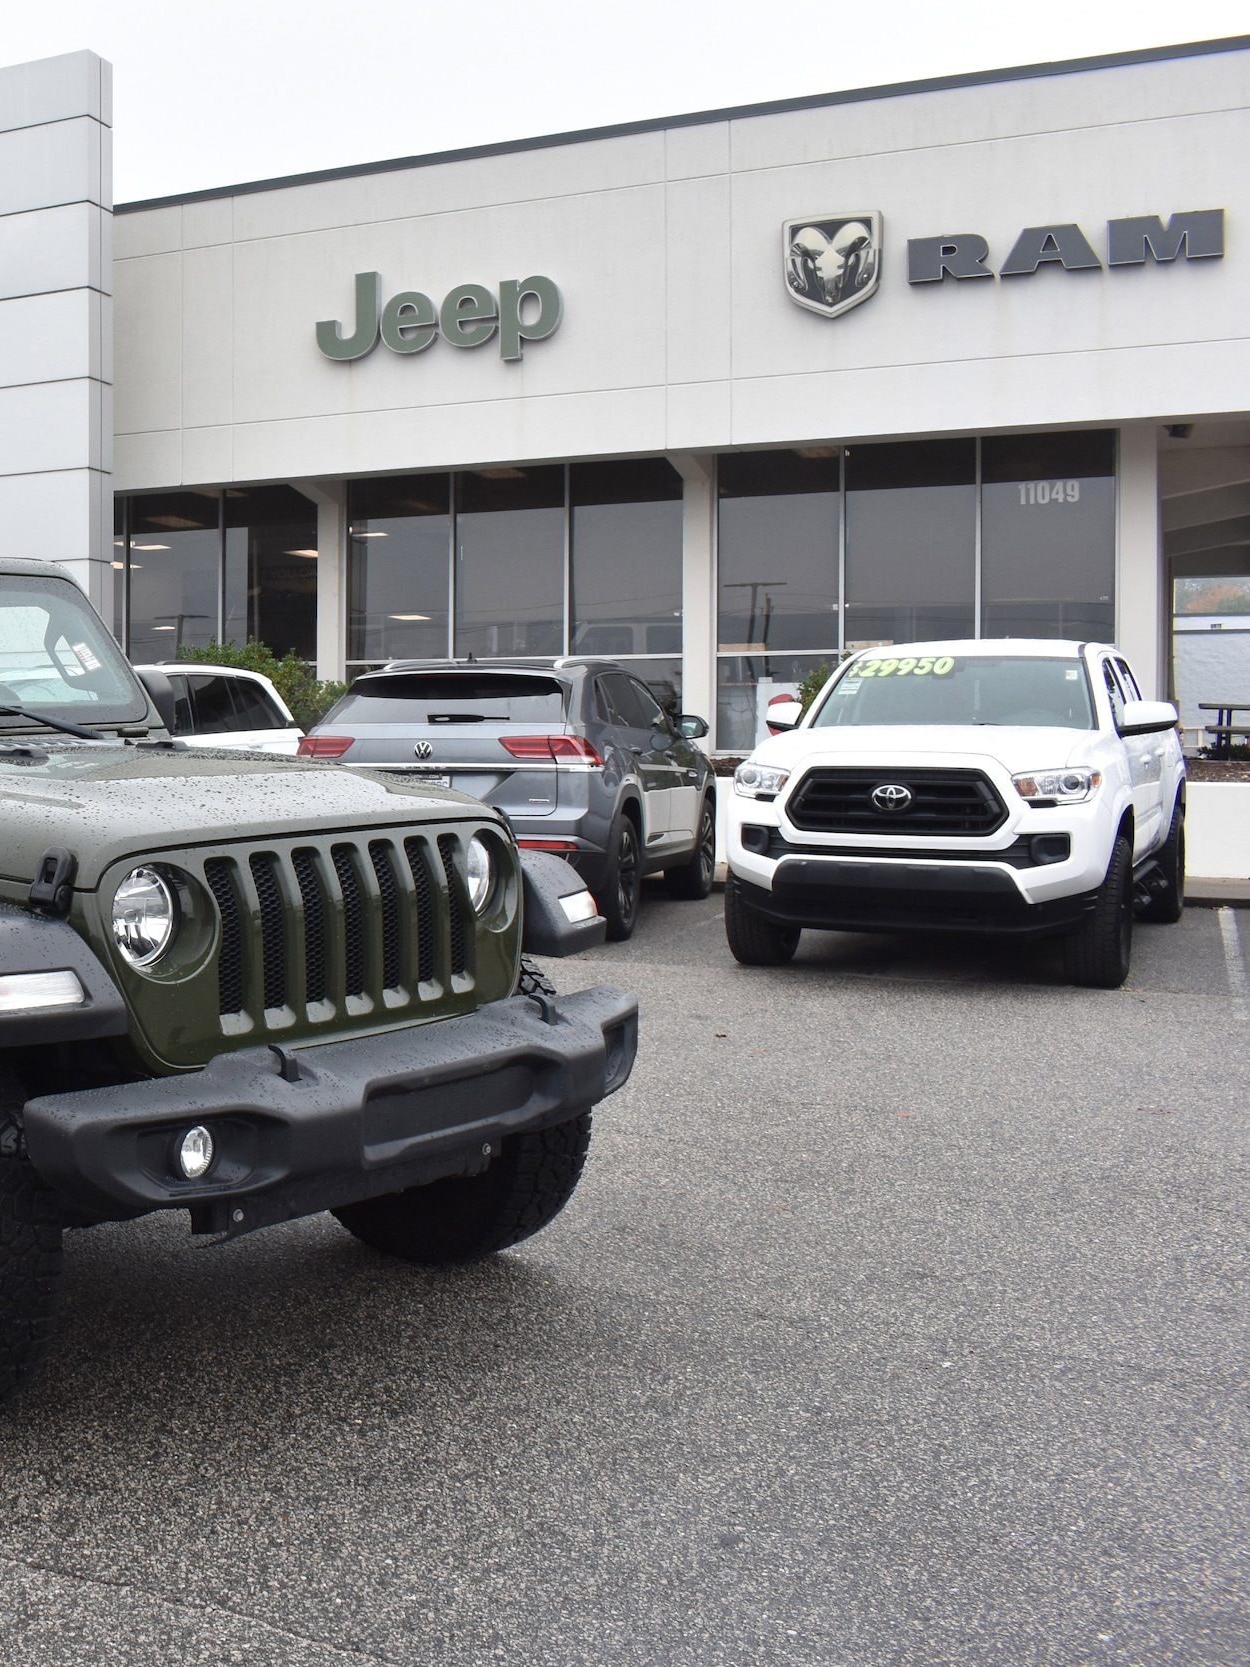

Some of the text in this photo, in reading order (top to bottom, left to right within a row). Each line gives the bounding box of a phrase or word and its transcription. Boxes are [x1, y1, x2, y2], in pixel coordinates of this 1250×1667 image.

[907, 208, 1225, 285] RAM
[316, 271, 564, 362] Jeep
[1018, 480, 1080, 505] 11049
[848, 657, 955, 678] $29950
